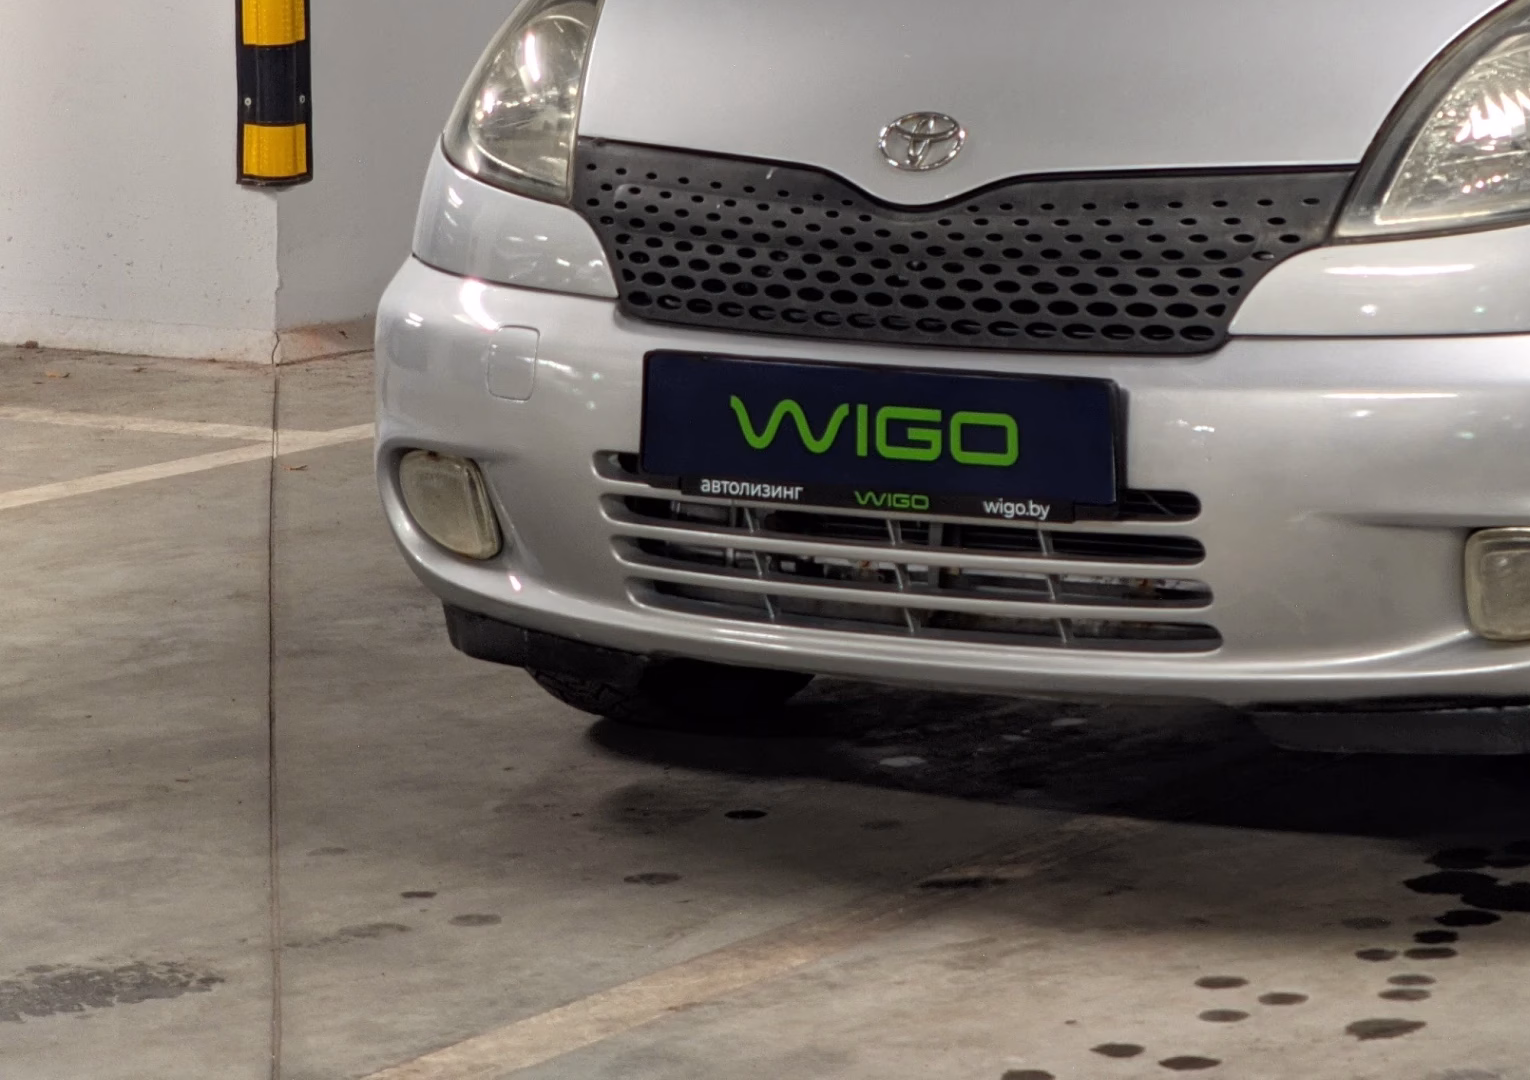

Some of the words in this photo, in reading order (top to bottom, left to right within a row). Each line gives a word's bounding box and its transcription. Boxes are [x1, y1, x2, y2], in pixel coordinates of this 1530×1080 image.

[730, 395, 1018, 467] WIGO
[700, 478, 803, 502] автолизинг
[855, 491, 929, 510] WIGO
[983, 497, 1051, 521] wigo.by
